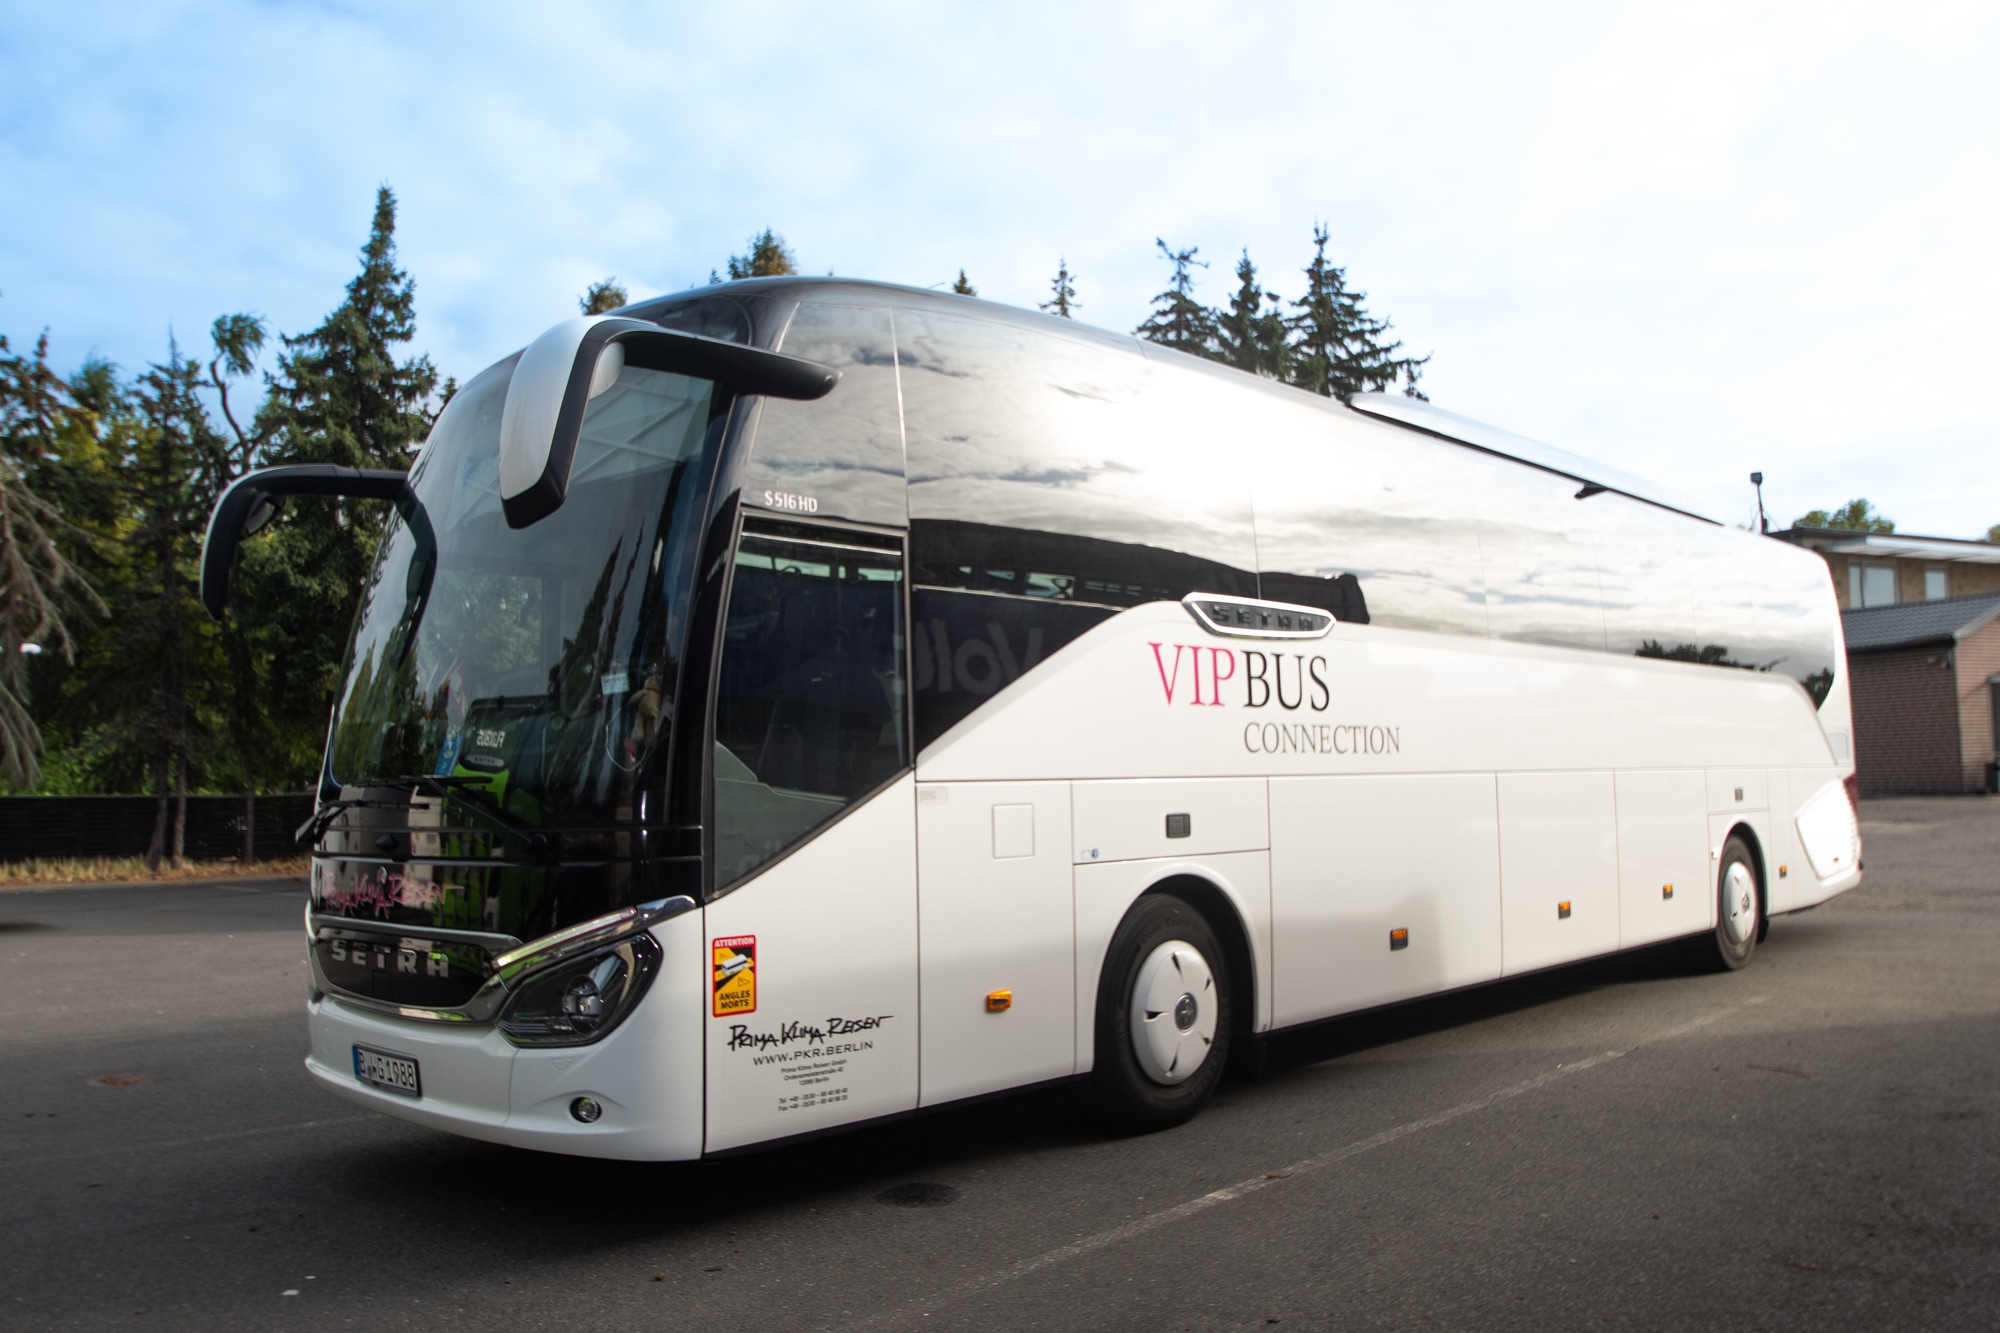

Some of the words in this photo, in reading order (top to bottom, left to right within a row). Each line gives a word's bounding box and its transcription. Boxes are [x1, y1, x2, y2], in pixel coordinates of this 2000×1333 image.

[764, 490, 773, 507] S
[775, 492, 797, 510] 516
[797, 495, 818, 513] HD
[1211, 605, 1314, 632] SETRA
[1243, 721, 1400, 755] CONNECTION
[714, 937, 755, 948] ATTENTION
[332, 938, 449, 979] SETRA
[719, 990, 751, 1002] ANGLES
[720, 999, 750, 1010] MORTS
[752, 1041, 874, 1067] WWW.PKR.BERLIN
